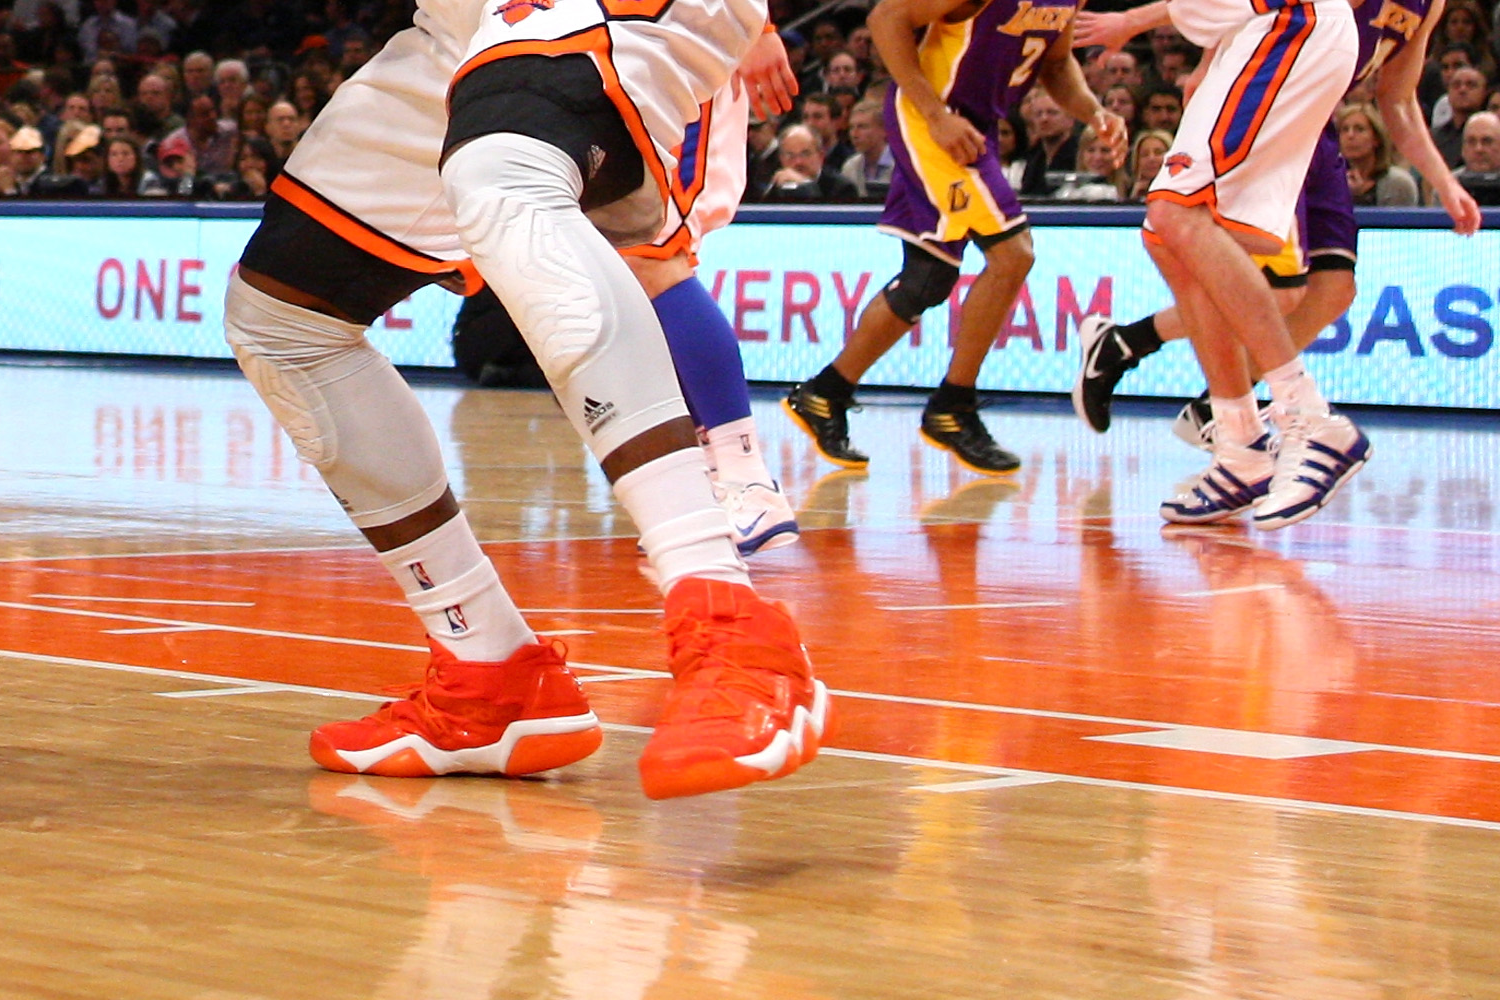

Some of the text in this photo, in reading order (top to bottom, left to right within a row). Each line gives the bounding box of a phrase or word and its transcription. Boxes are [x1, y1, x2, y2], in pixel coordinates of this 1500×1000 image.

[1007, 36, 1048, 88] 2
[96, 258, 205, 323] ONE
[909, 274, 1114, 352] EAM
